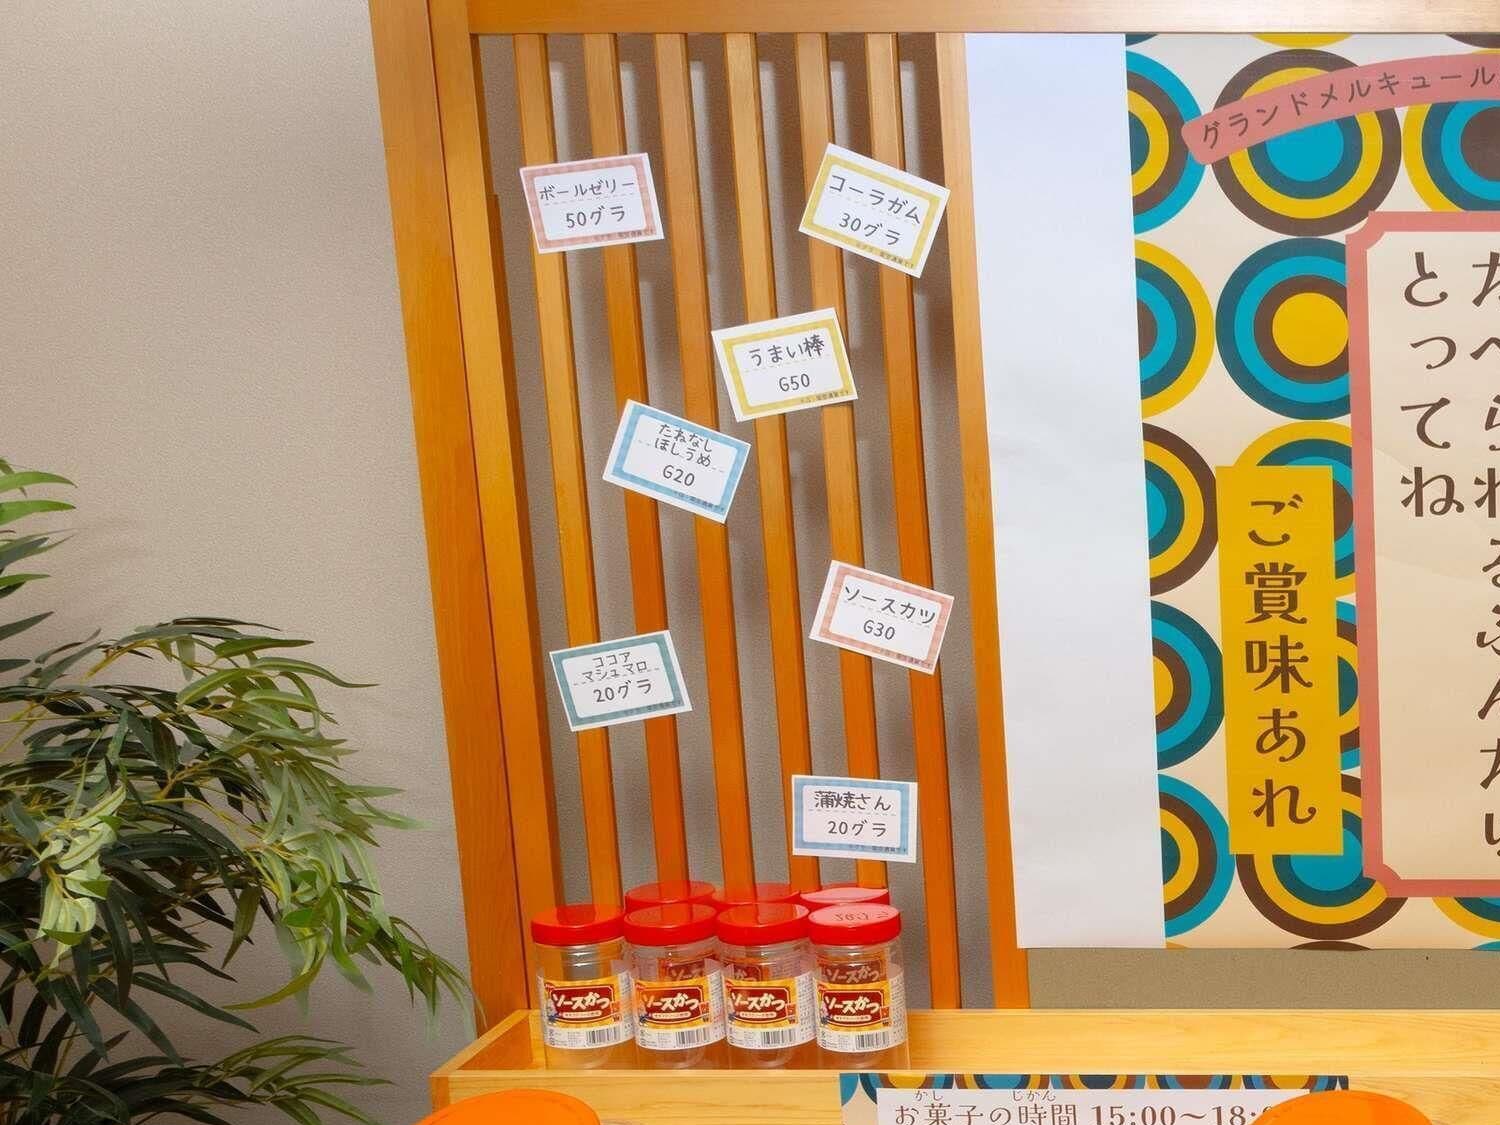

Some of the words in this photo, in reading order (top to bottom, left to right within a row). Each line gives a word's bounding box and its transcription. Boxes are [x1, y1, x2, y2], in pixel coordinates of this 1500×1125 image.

[538, 178, 636, 200] ボールゼリー
[828, 173, 922, 226] コーラガム
[564, 205, 626, 229] 50グラ
[838, 212, 902, 247] 30グラ
[749, 334, 825, 367] うまい棒
[778, 373, 811, 393] G50
[1400, 250, 1465, 518] とってね
[657, 423, 714, 453] たねなし
[653, 438, 713, 468] ほしうめ
[662, 464, 695, 487] G20
[843, 585, 936, 625] ソースカツ
[863, 619, 896, 641] G30
[592, 650, 630, 668] ココア
[1244, 493, 1316, 828] ご賞味あれ
[581, 660, 648, 684] マシュマロ
[592, 678, 652, 704] 20グラ
[813, 790, 892, 813] 蒲焼さん
[827, 820, 887, 838] 20グラ
[552, 991, 610, 1010] ソースかつ
[643, 992, 699, 1011] ソースかつ
[731, 992, 785, 1011] ソースかつ
[824, 995, 880, 1014] ソースかつ
[914, 1089, 944, 1101] かし
[1012, 1089, 1057, 1102] じかん
